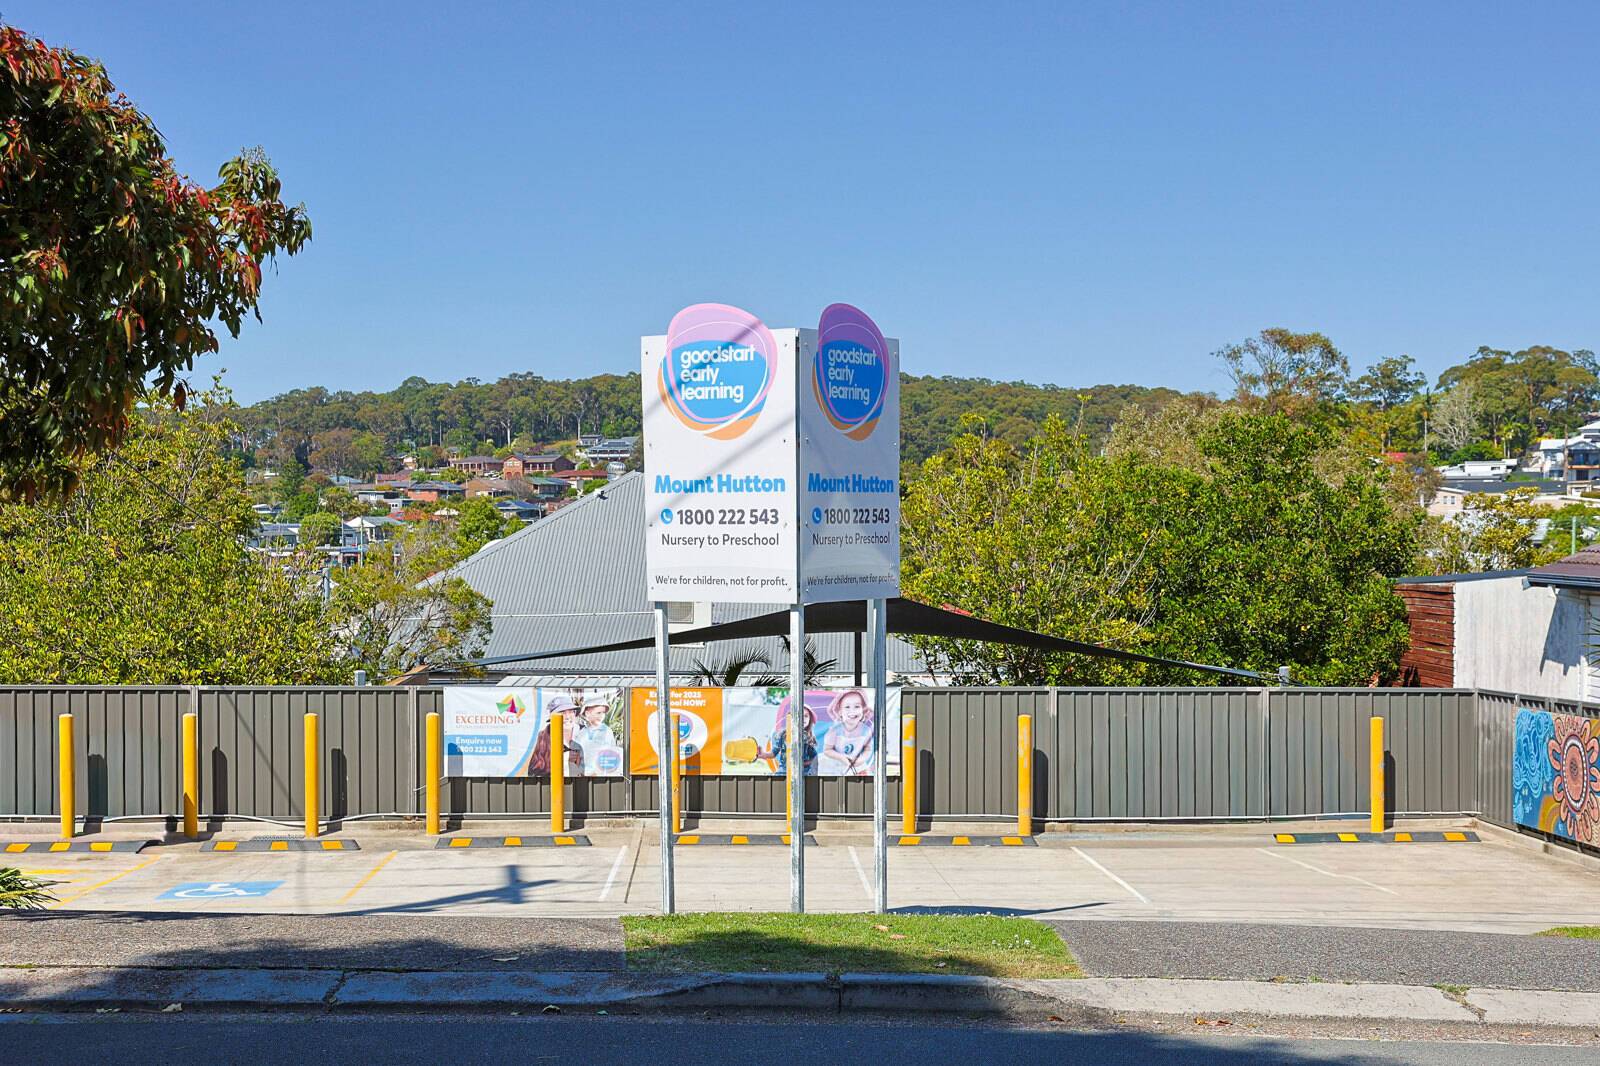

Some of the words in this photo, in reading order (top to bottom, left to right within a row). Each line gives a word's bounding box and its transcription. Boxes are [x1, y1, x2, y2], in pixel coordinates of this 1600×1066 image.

[680, 346, 756, 368] goodstart
[828, 347, 877, 366] goodstart
[680, 366, 720, 384] early
[828, 366, 855, 384] early
[681, 383, 745, 403] learning
[828, 382, 870, 405] learning
[654, 474, 714, 494] Mount
[717, 473, 786, 493] Hutton
[807, 473, 850, 493] Mount
[852, 473, 894, 493] Hutton
[676, 509, 715, 525] 1800
[718, 509, 746, 525] 222
[749, 508, 779, 525] 543
[824, 508, 851, 524] 1800
[852, 508, 870, 524] 222
[872, 508, 890, 524] 543
[661, 533, 706, 549] Nursery
[707, 535, 719, 546] to
[723, 533, 779, 546] Preschool
[812, 533, 844, 548] Nursery
[845, 534, 854, 545] to
[855, 533, 890, 545] Preschool
[655, 575, 677, 585] We're
[678, 575, 692, 585] for
[692, 575, 728, 588] children,
[730, 576, 745, 586] not
[746, 576, 759, 586] for
[760, 576, 788, 588] profit.
[807, 575, 824, 585] We're
[825, 575, 833, 585] for
[834, 575, 858, 585] children,
[859, 575, 868, 583] not
[869, 573, 877, 583] for
[455, 715, 514, 724] EXCEEDING
[455, 736, 484, 746] Enquire
